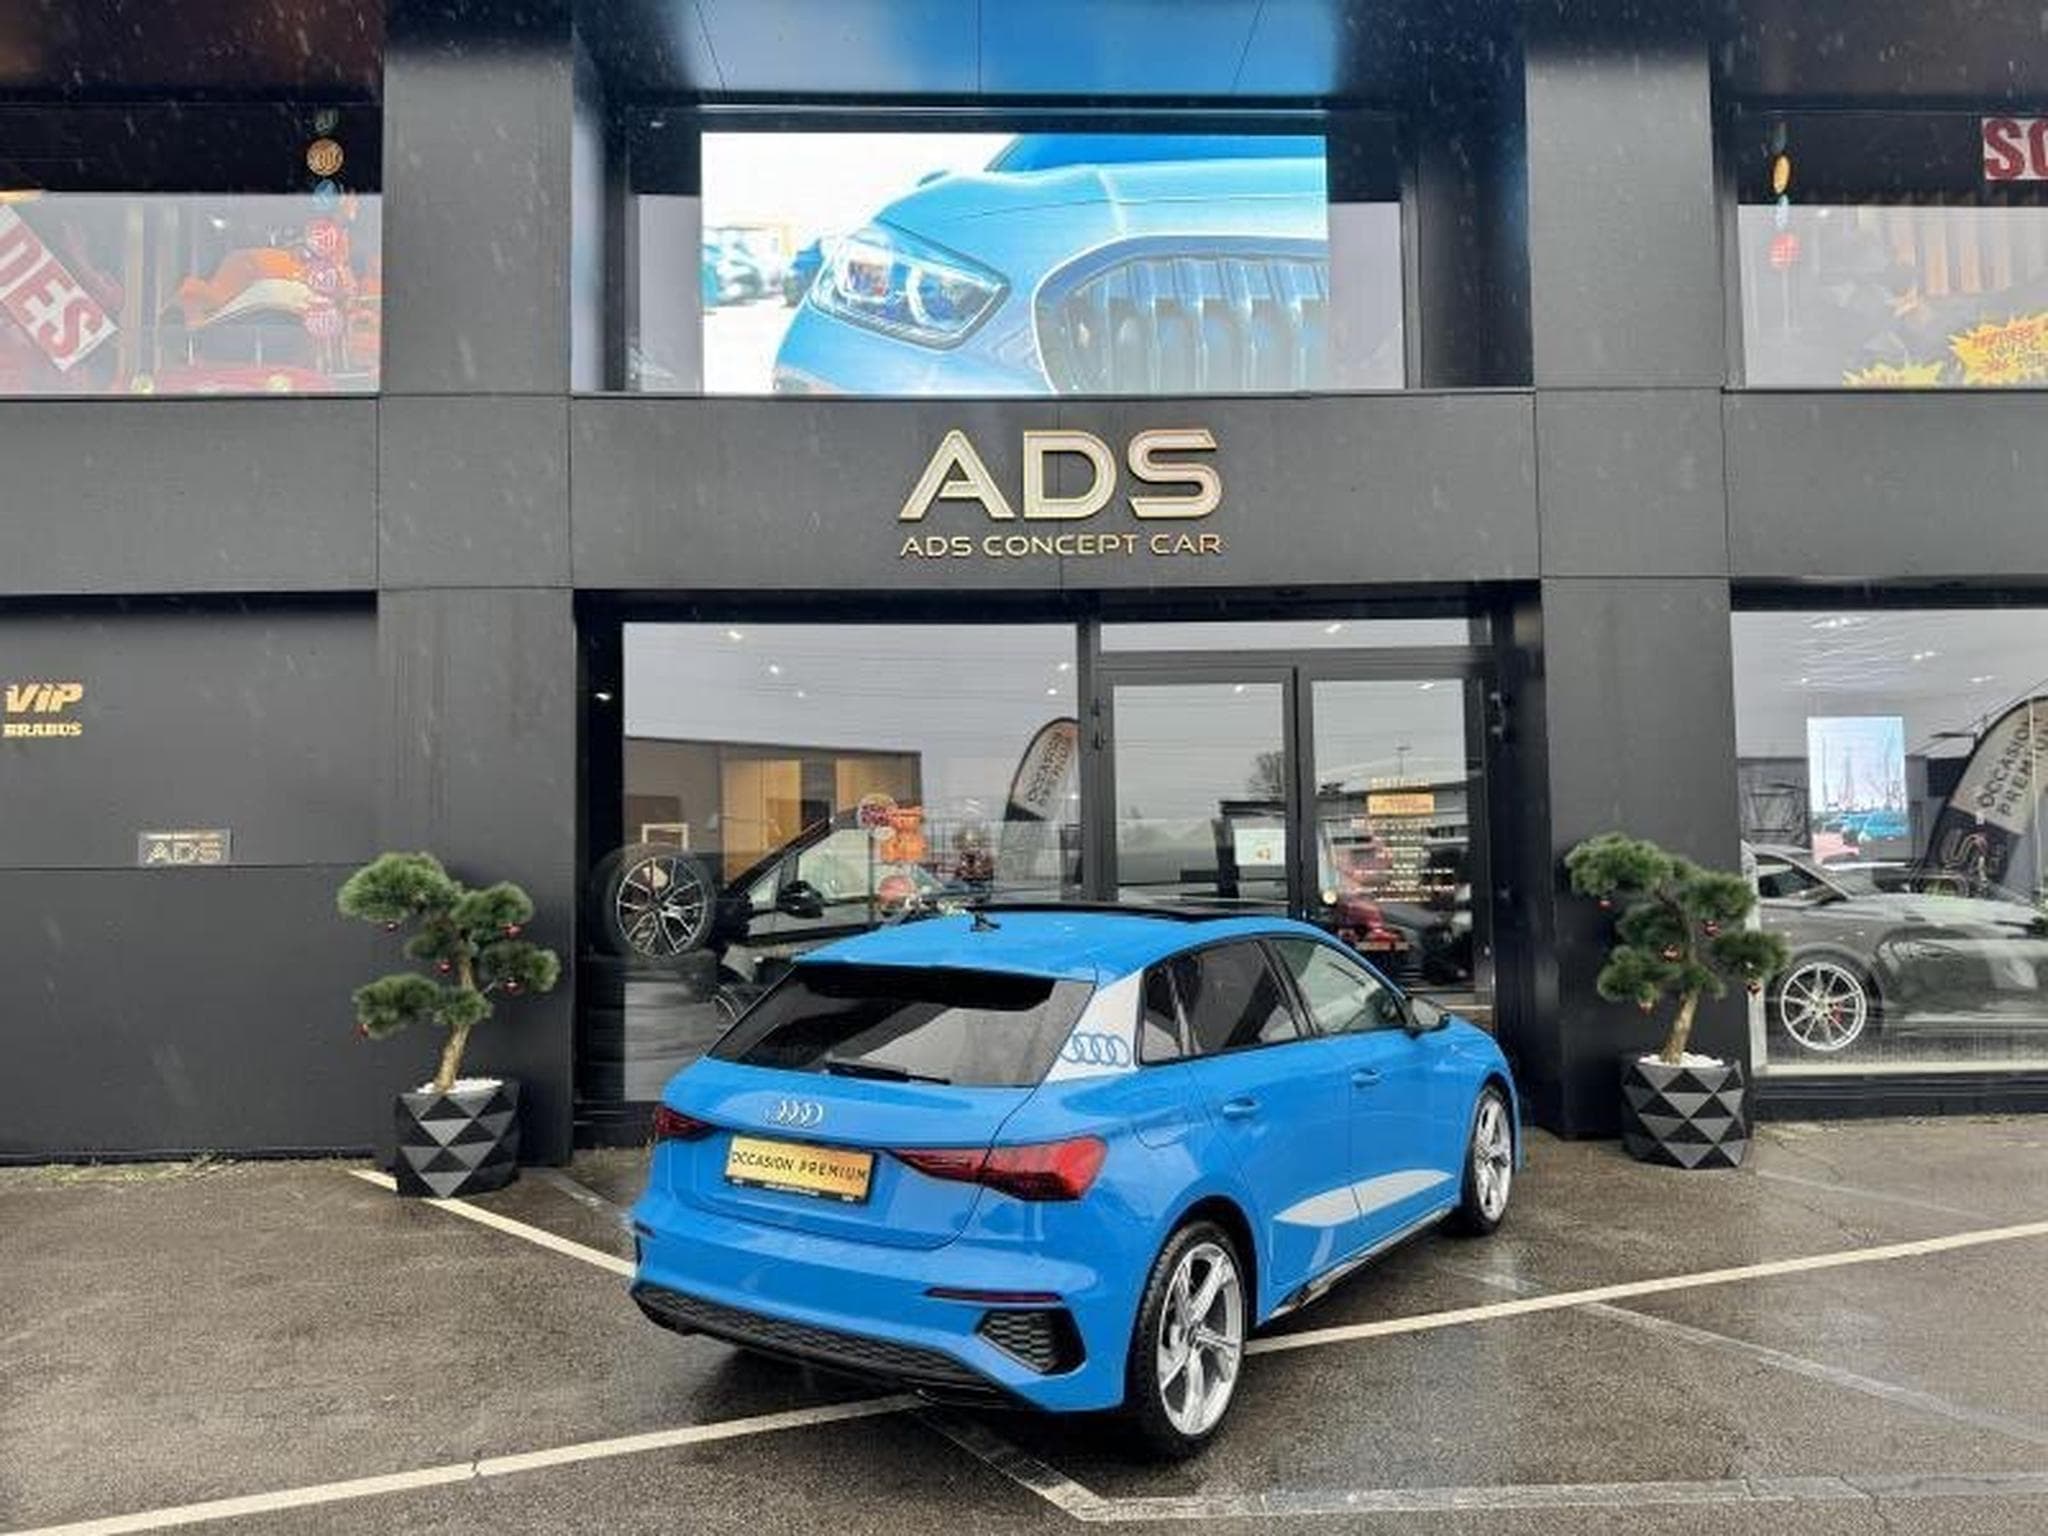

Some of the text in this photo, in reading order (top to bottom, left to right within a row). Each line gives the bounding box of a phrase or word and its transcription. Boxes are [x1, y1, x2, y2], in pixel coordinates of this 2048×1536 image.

[899, 429, 1222, 520] ADS
[900, 533, 1222, 557] ADS CONCEPT CAR
[732, 1151, 867, 1182] OCCASION PREMIUM
